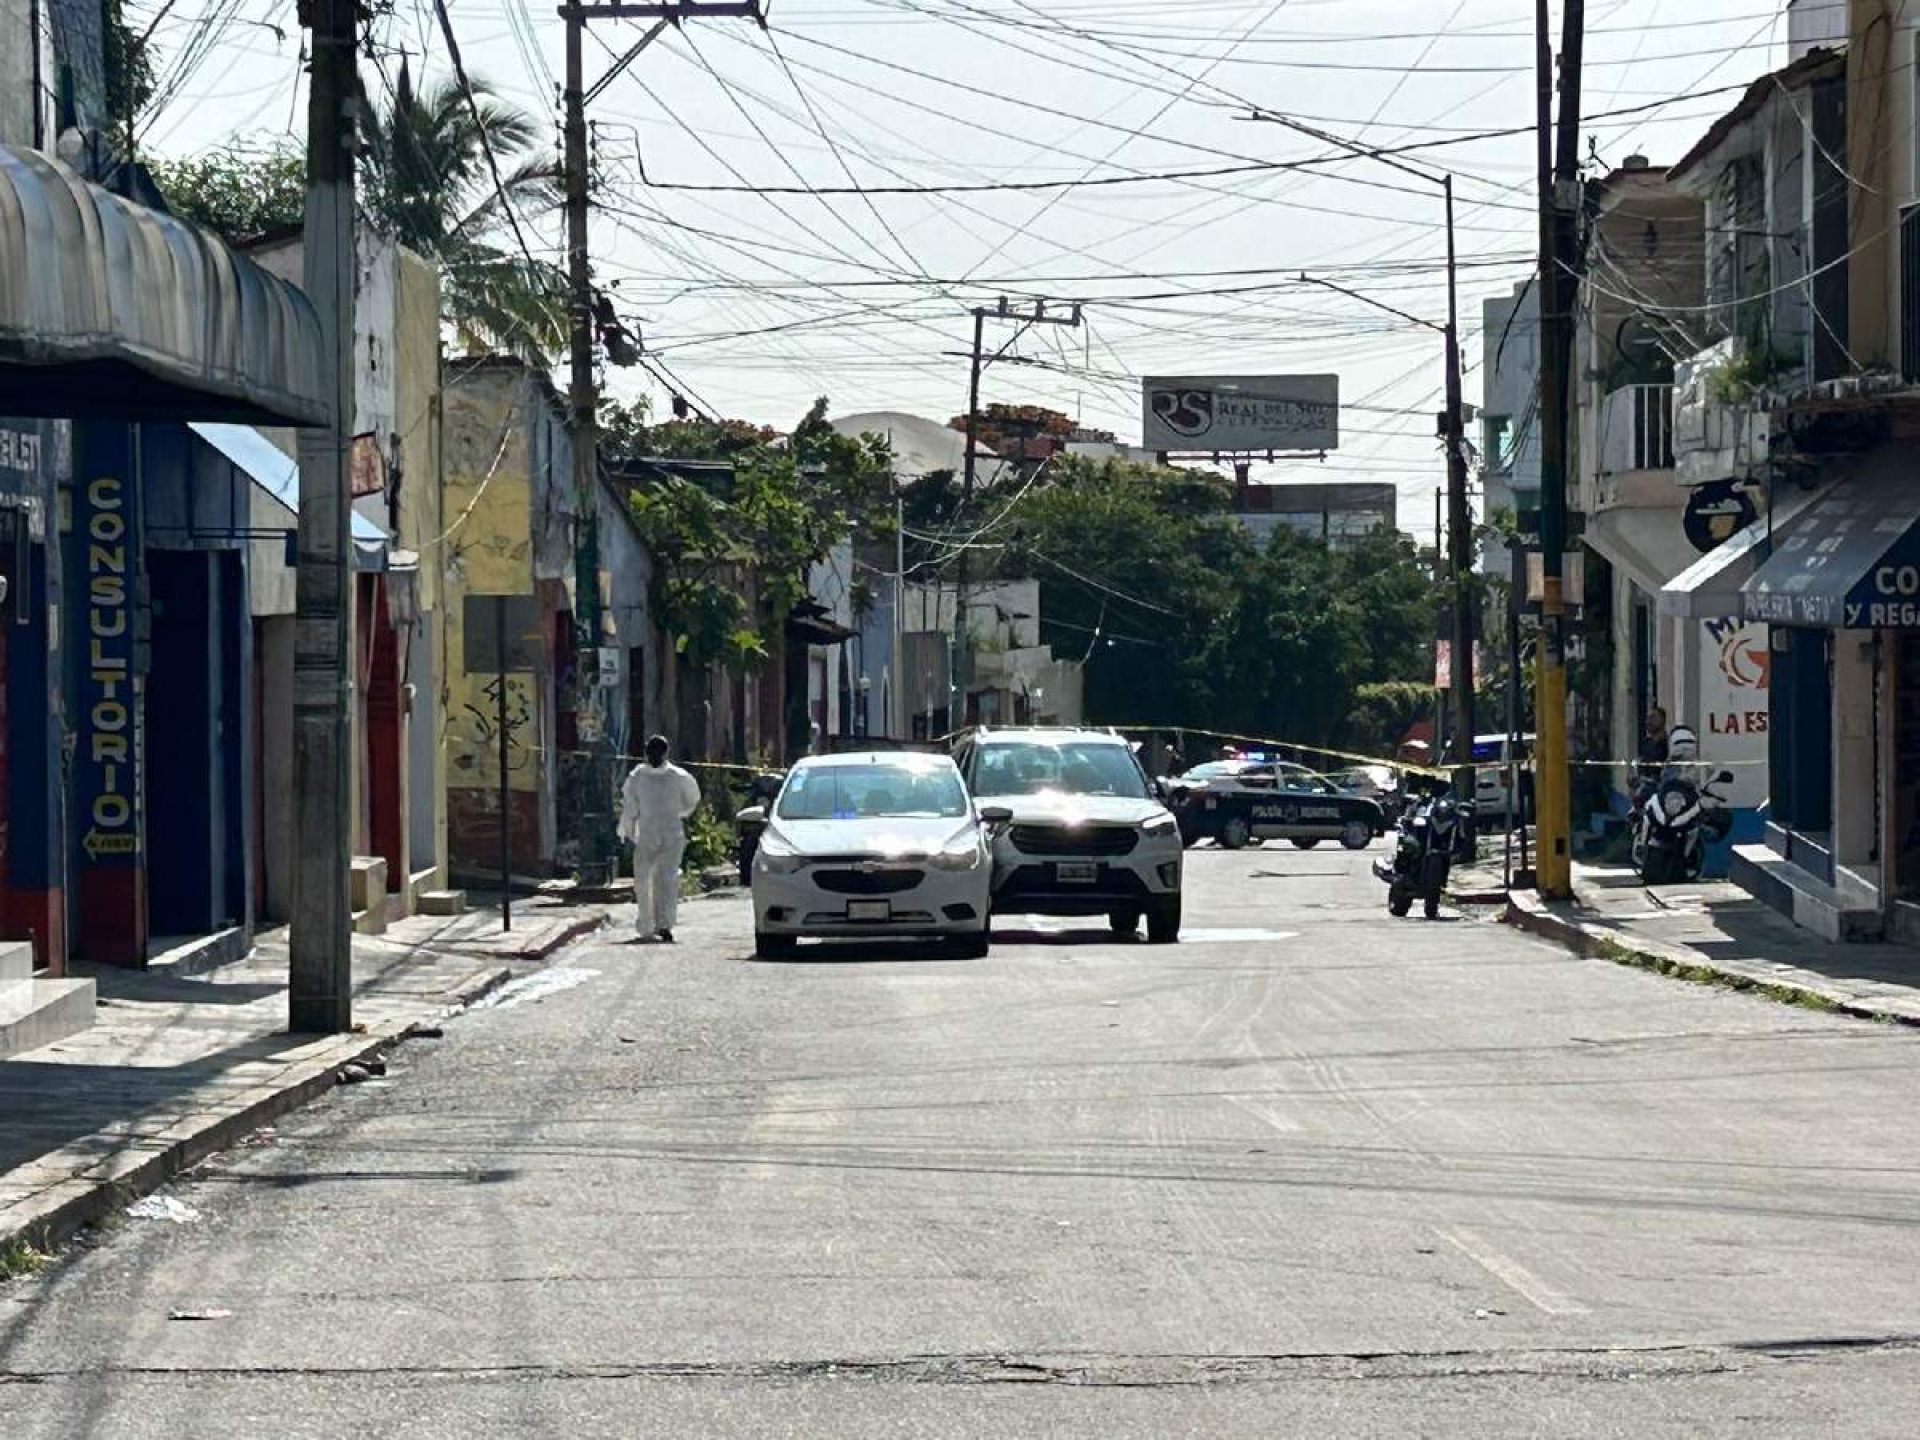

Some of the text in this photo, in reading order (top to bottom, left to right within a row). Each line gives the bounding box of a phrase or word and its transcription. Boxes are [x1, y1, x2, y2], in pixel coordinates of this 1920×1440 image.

[1845, 602, 1862, 625] Y
[1870, 602, 1920, 627] REG
[88, 478, 129, 827] CONSULTORIO
[1709, 712, 1740, 734] LA
